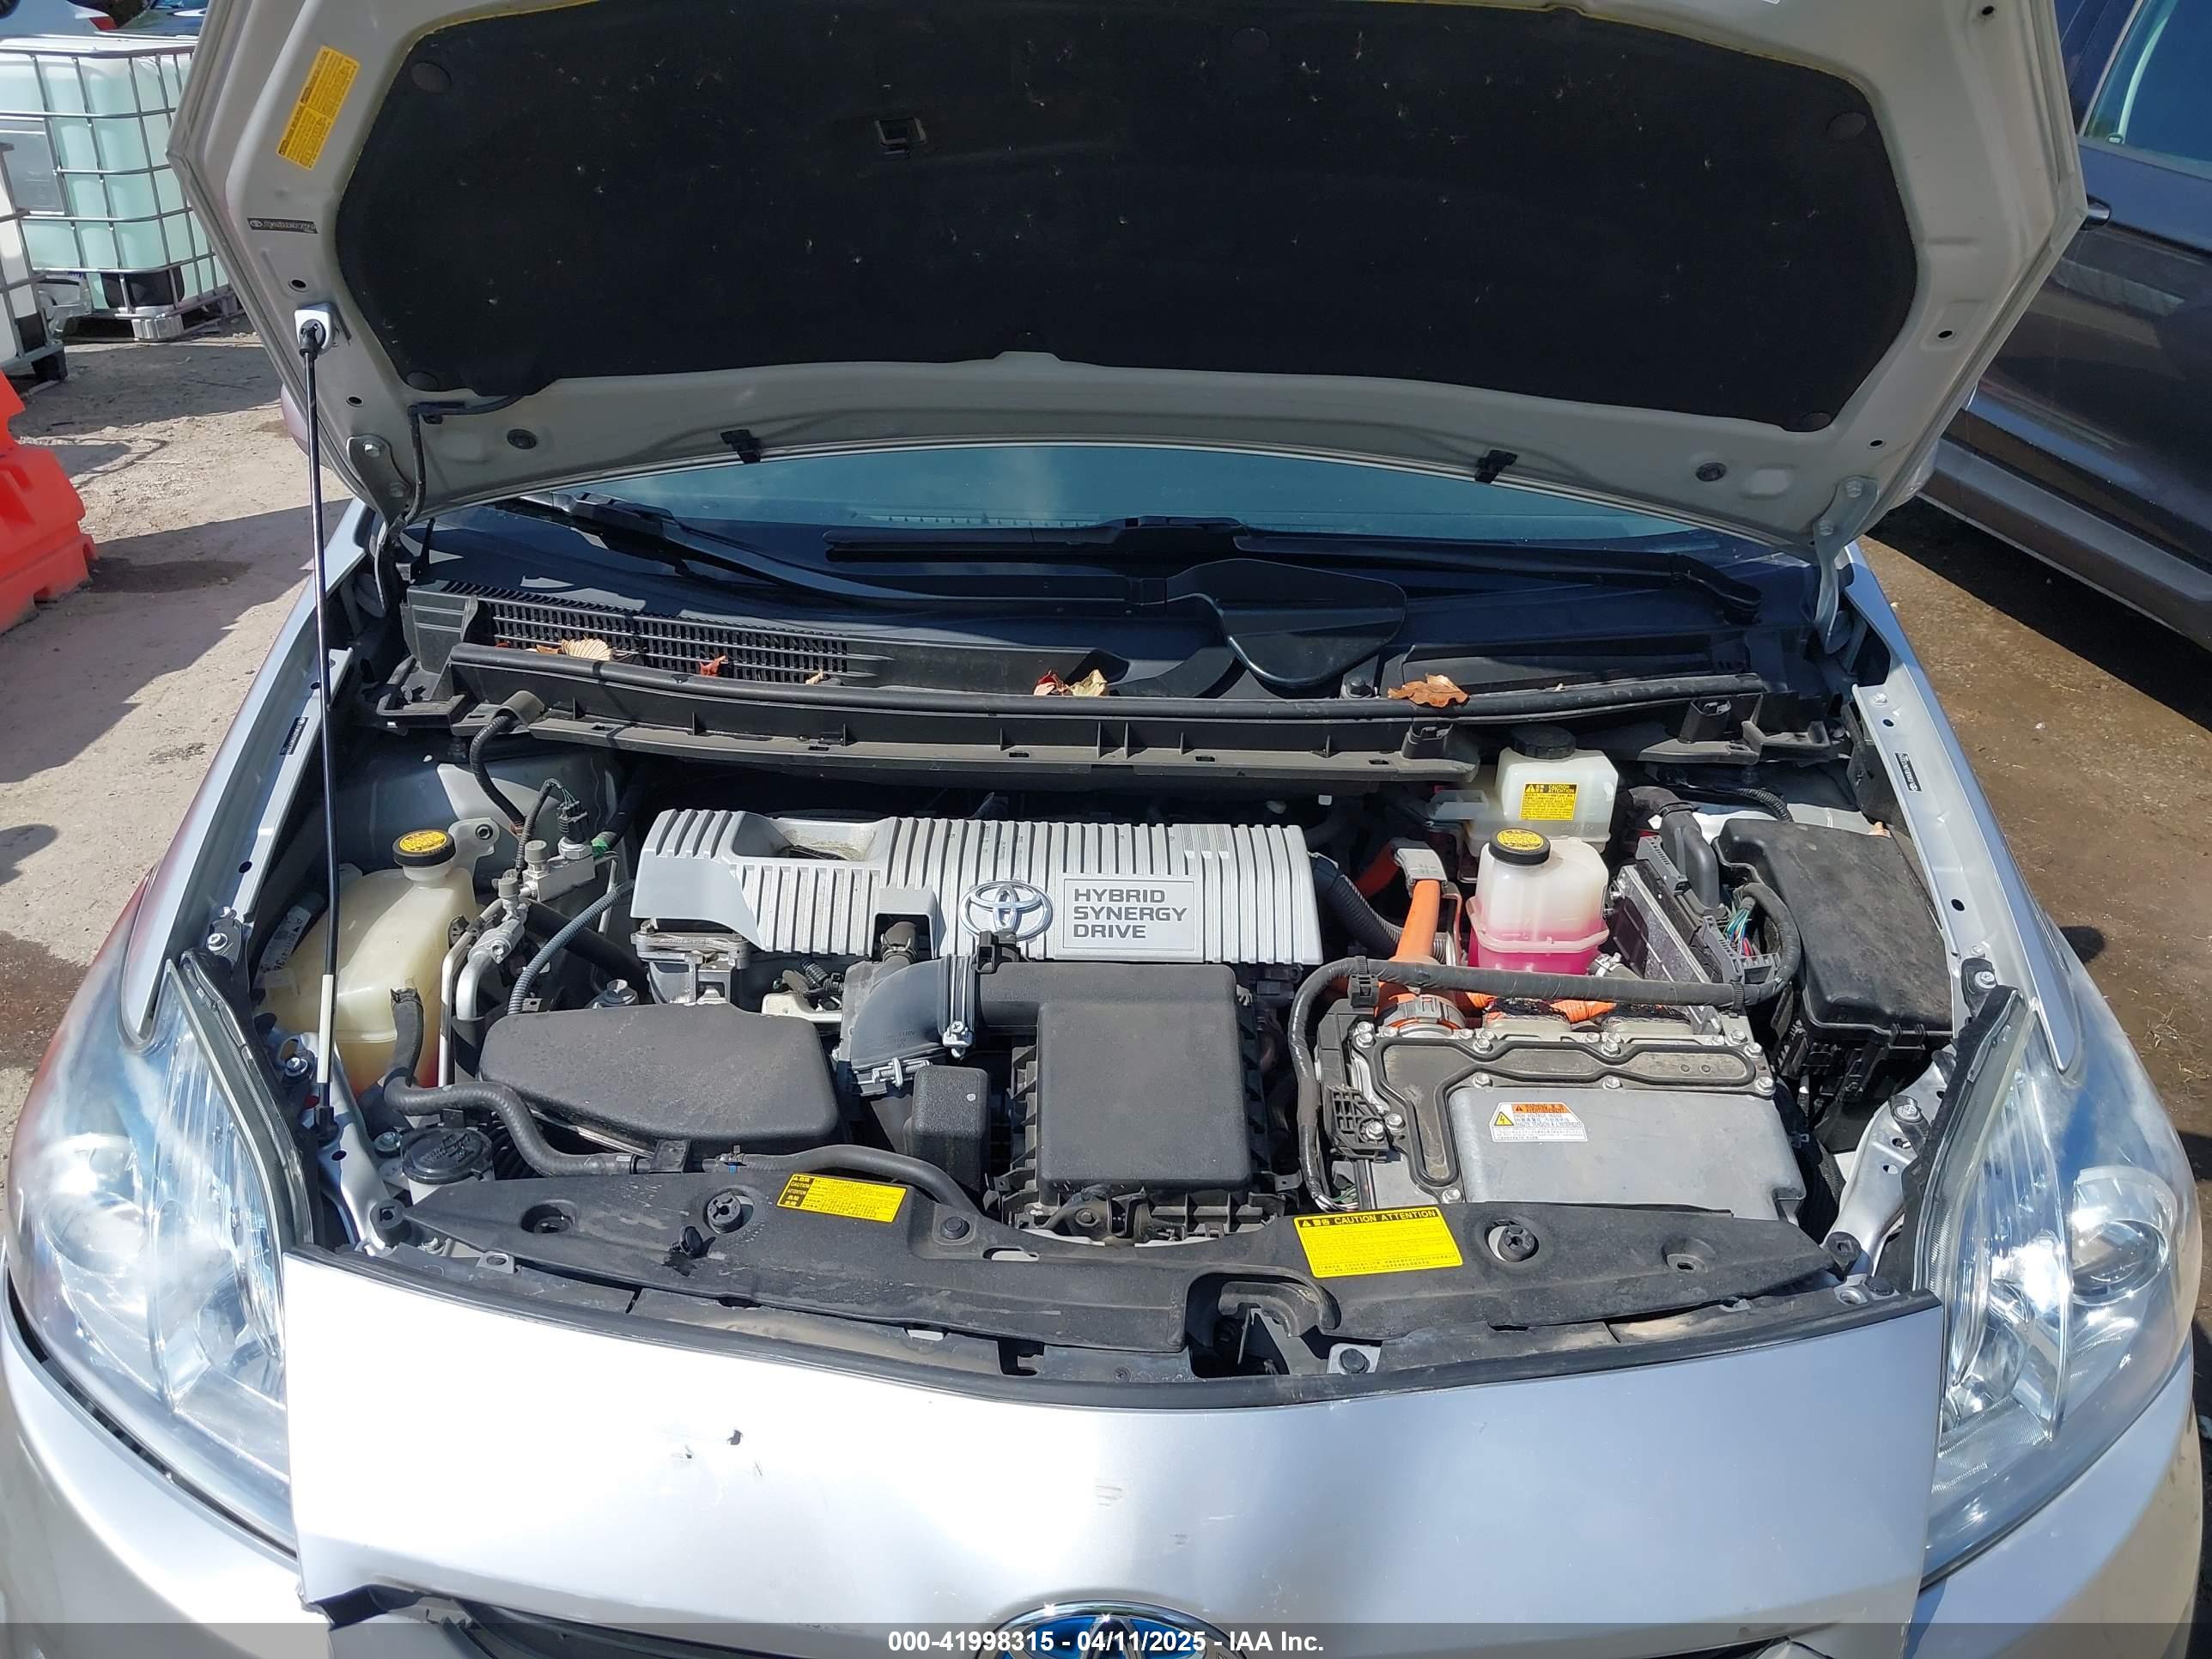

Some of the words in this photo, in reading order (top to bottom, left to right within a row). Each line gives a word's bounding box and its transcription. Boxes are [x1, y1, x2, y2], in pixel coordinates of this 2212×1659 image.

[1073, 888, 1165, 903] HYBRID
[1073, 905, 1188, 922] SYNERGY
[1073, 923, 1147, 939] DRIVE
[1334, 1214, 1377, 1224] CAUTION
[1381, 1209, 1437, 1222] ATTENTION
